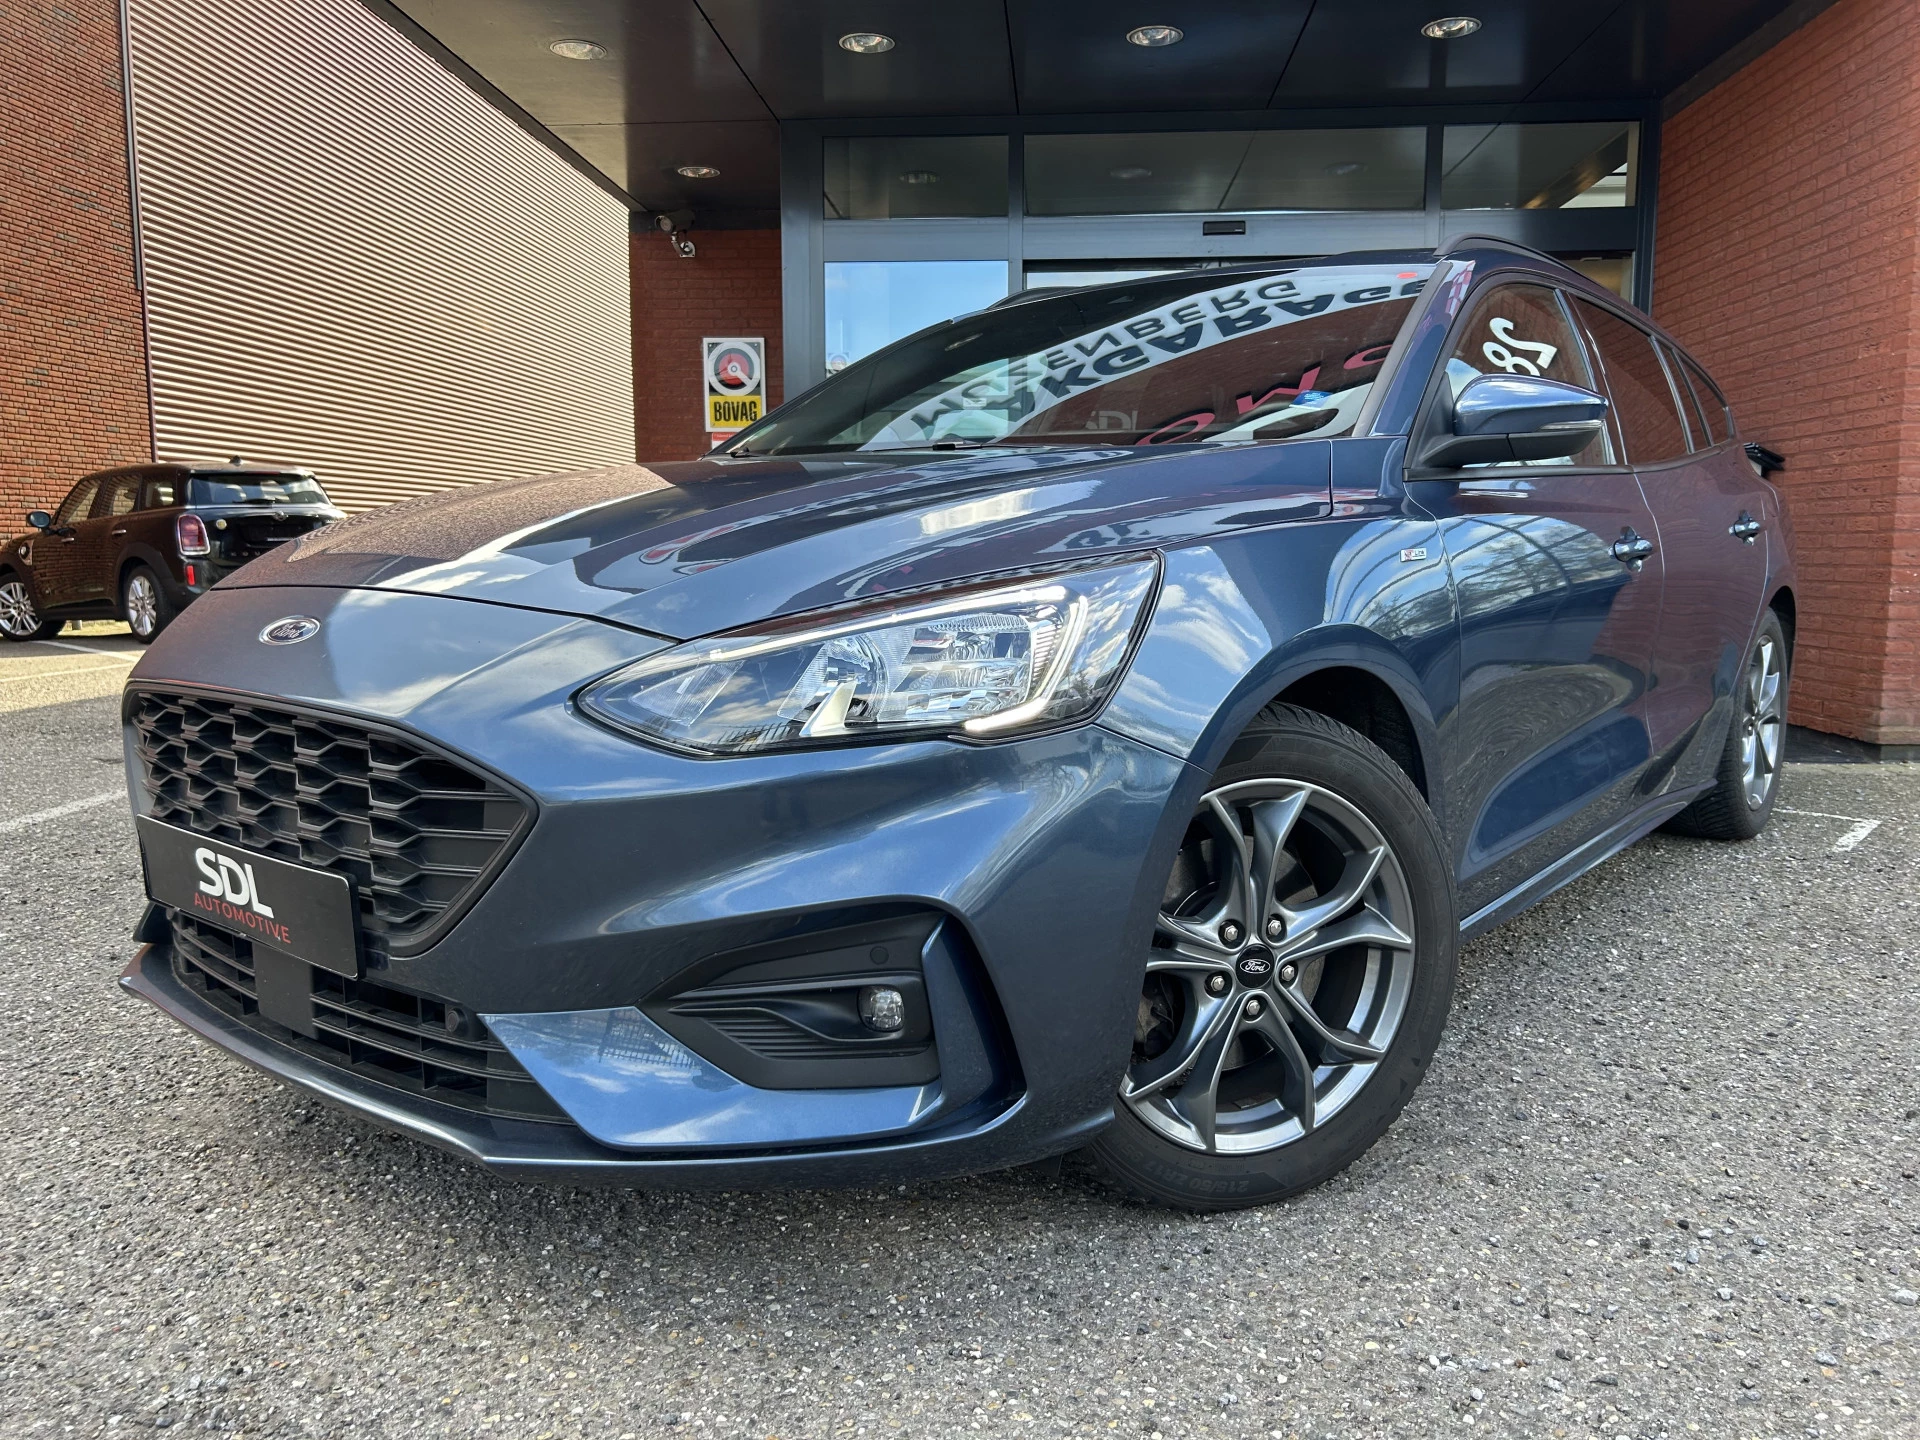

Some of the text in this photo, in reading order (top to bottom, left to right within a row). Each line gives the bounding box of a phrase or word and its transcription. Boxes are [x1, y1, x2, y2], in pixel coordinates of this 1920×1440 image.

[713, 400, 758, 422] BOVAG
[195, 846, 275, 919] SDL
[193, 892, 292, 945] AUTOMOTIVE
[1244, 959, 1267, 973] Ford
